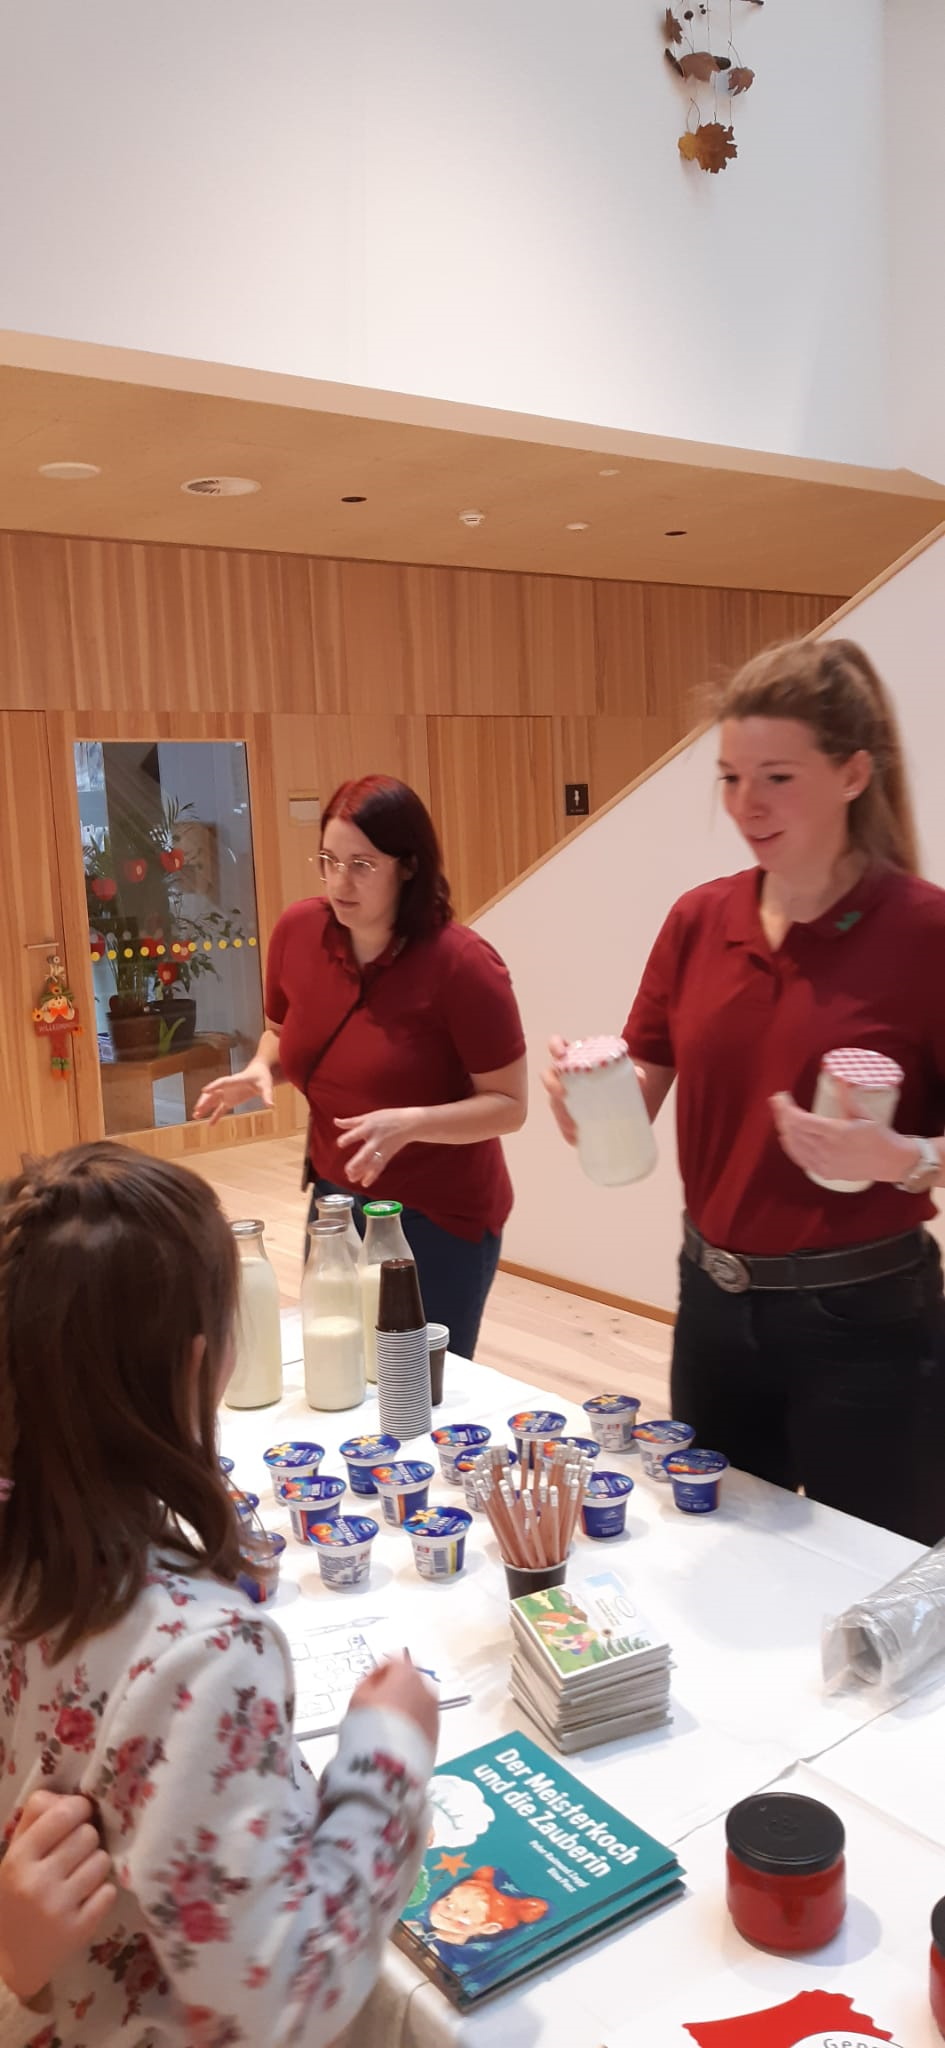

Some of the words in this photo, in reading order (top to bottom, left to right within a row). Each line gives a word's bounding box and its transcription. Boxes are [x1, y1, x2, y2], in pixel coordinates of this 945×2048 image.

[473, 1764, 517, 1795] und
[502, 1790, 537, 1817] die
[527, 1810, 612, 1878] Zauberin
[494, 1748, 534, 1777] Der
[523, 1772, 641, 1865] Meisterkoch
